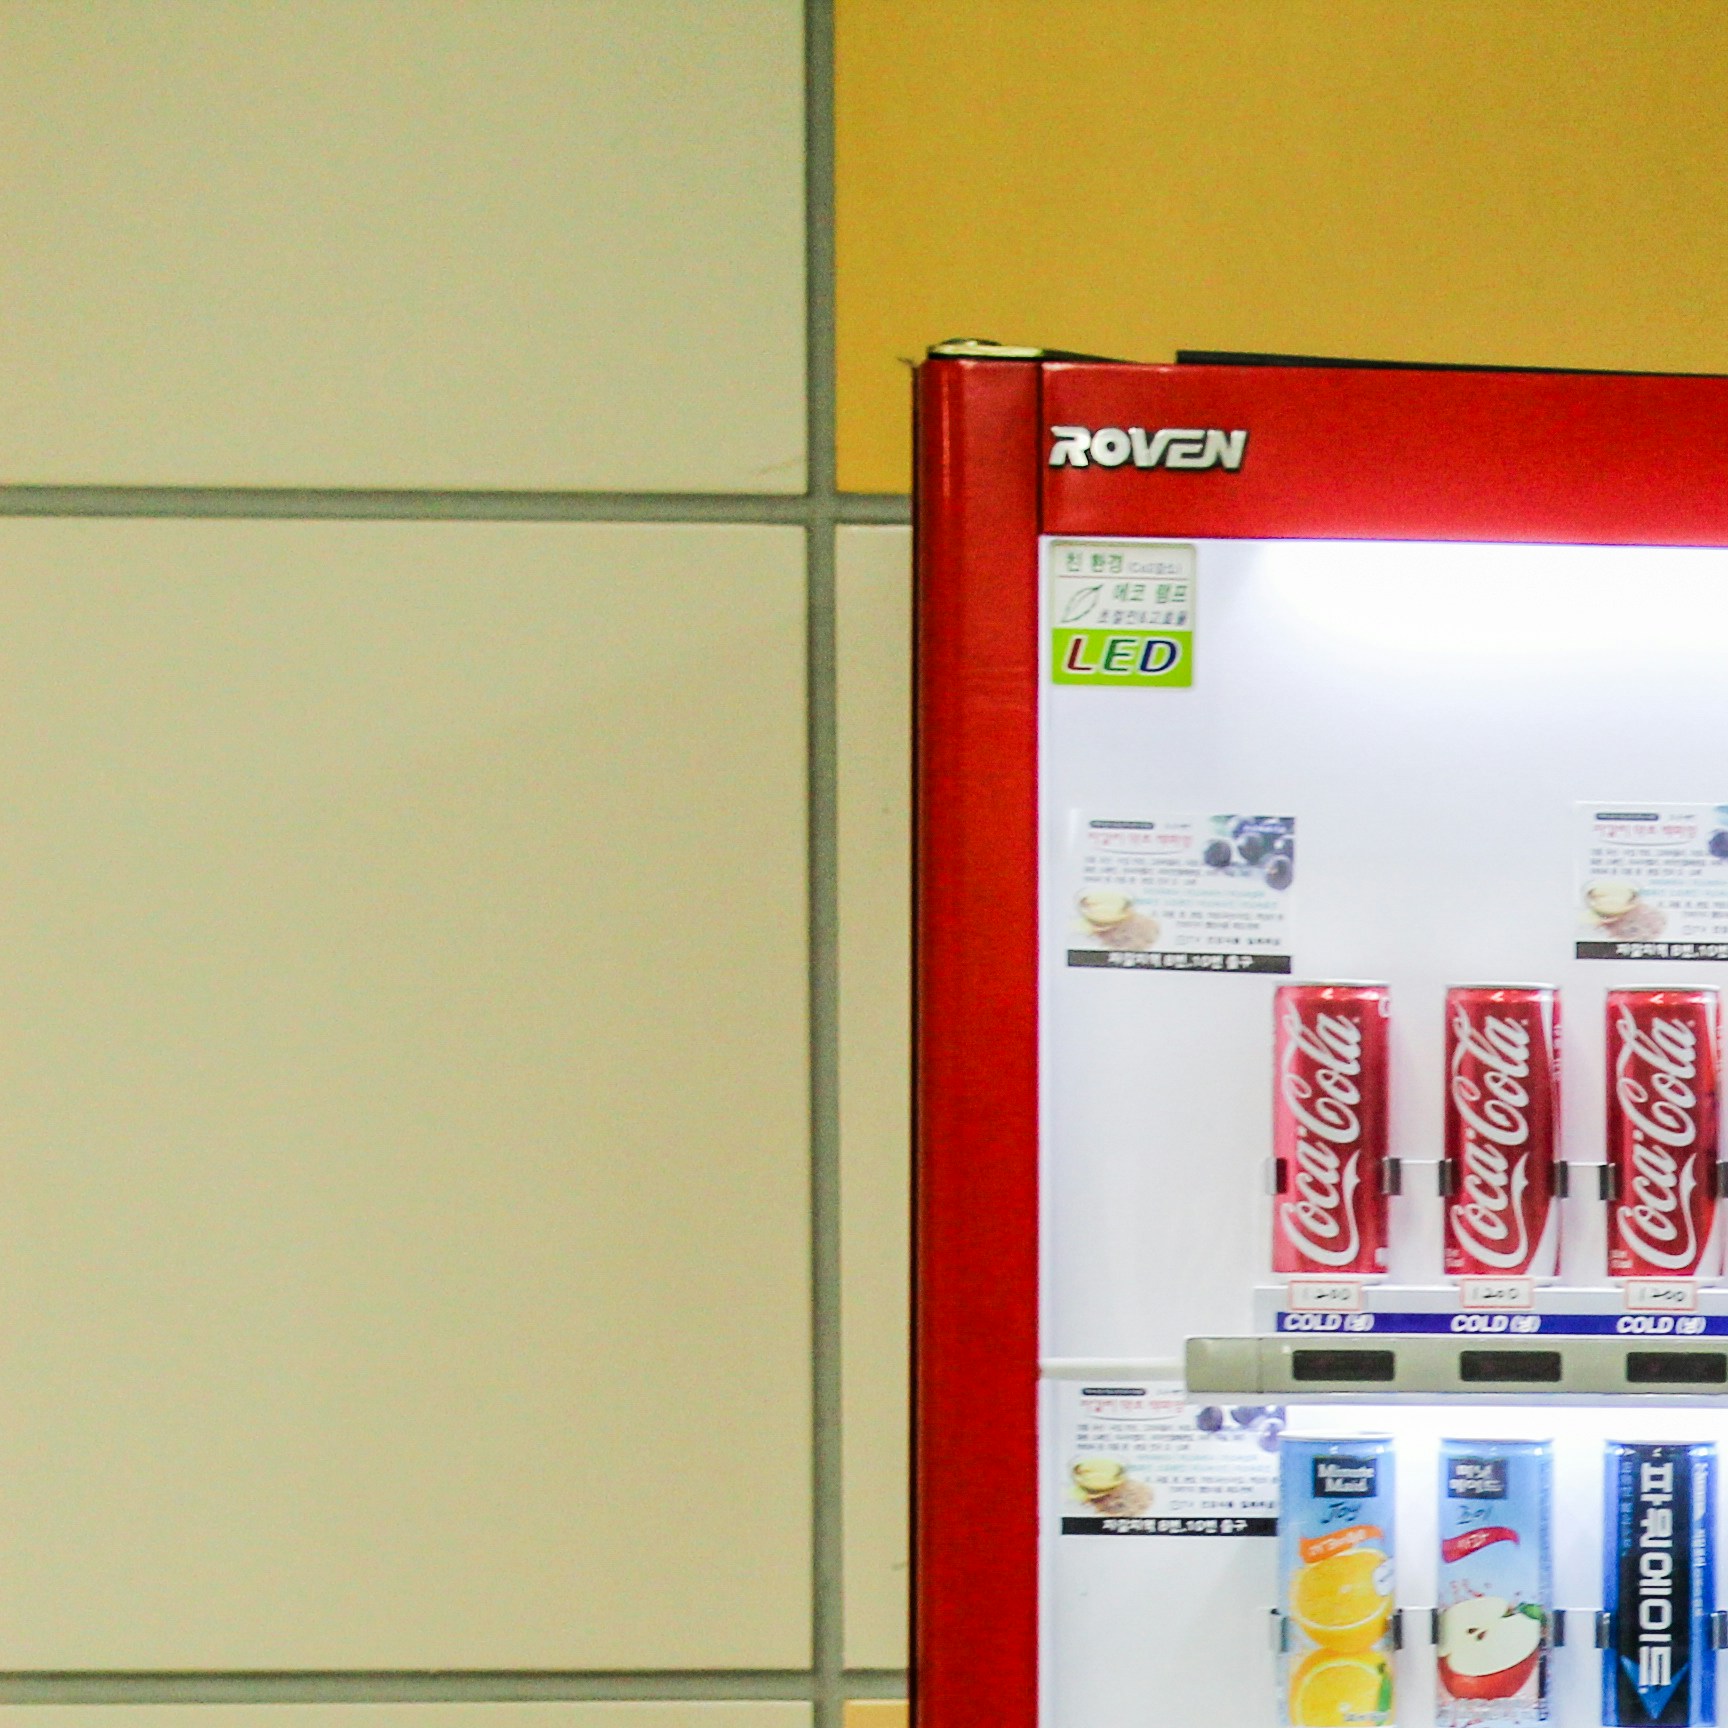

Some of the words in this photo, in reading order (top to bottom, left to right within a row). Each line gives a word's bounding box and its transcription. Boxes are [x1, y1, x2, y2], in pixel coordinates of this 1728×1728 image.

[1048, 424, 1248, 471] ROVEN
[1064, 636, 1179, 675] LED
[1280, 998, 1361, 1267] Coca-Cola
[1452, 1001, 1530, 1269] Coca-Cola
[1616, 1002, 1697, 1270] Coca-Cola
[1284, 1312, 1341, 1334] COLD
[1450, 1315, 1507, 1336] COLD
[1616, 1314, 1673, 1337] COLD
[1324, 1477, 1368, 1493] Maid
[1638, 1463, 1674, 1687] 파워에이드
